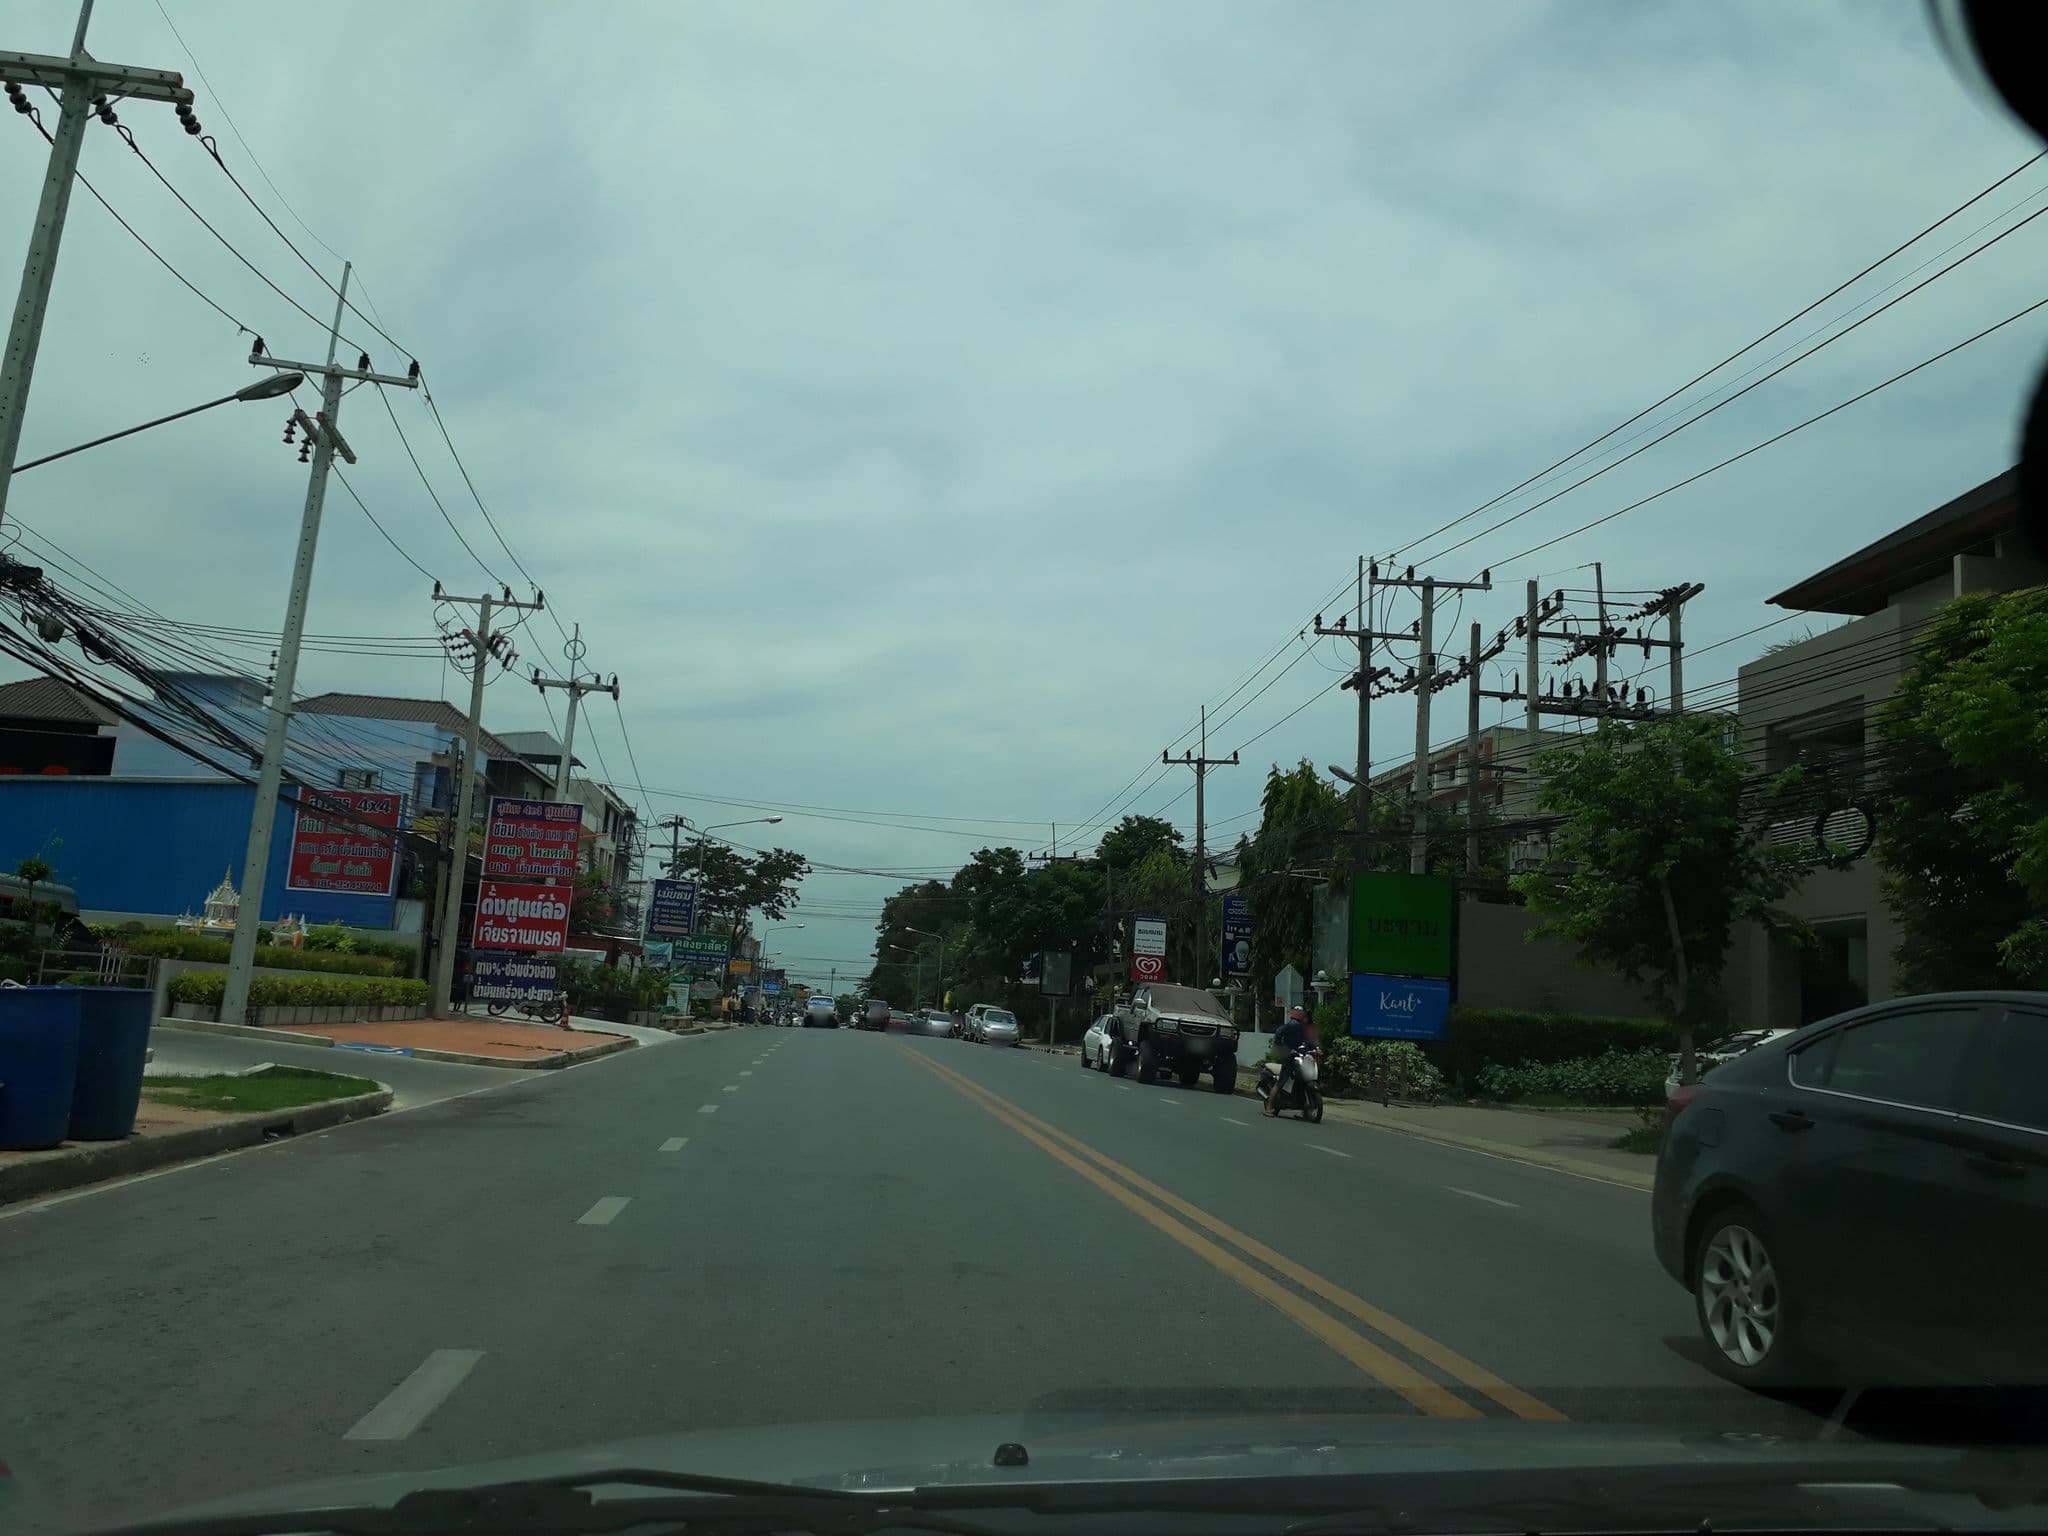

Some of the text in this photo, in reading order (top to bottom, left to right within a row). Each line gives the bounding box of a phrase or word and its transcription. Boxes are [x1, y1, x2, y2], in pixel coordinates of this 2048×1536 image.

[491, 844, 524, 860] ยกสูง
[489, 862, 510, 872] ยาง
[481, 885, 567, 923] ตั้งศูนย์ล้อ
[479, 920, 561, 947] เจียรจานเบรค
[675, 936, 729, 952] คลังยาสัตว์
[1379, 991, 1417, 1012] Kant
